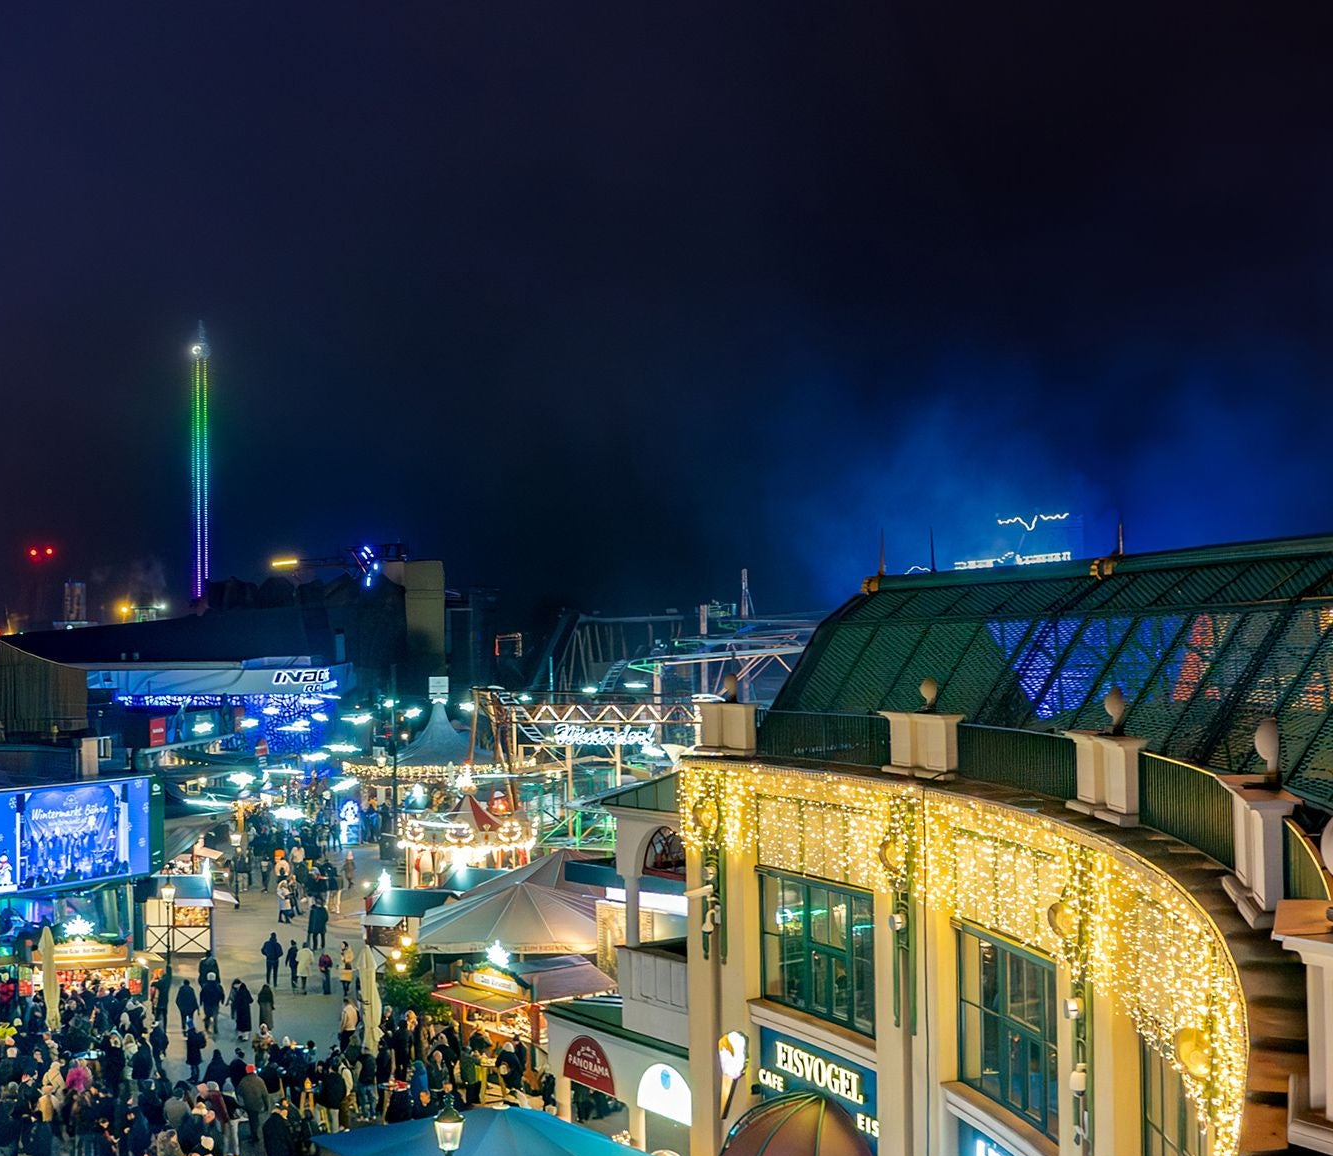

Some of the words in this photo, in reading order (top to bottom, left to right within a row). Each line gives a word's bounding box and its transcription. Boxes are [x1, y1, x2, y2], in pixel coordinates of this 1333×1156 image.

[31, 805, 82, 821] Wintermarkt
[85, 803, 108, 816] Bühne
[568, 1054, 611, 1079] PANORAMA
[775, 1041, 864, 1105] EISVOGEL
[758, 1068, 784, 1092] CAFE
[856, 1112, 880, 1138] EIS
